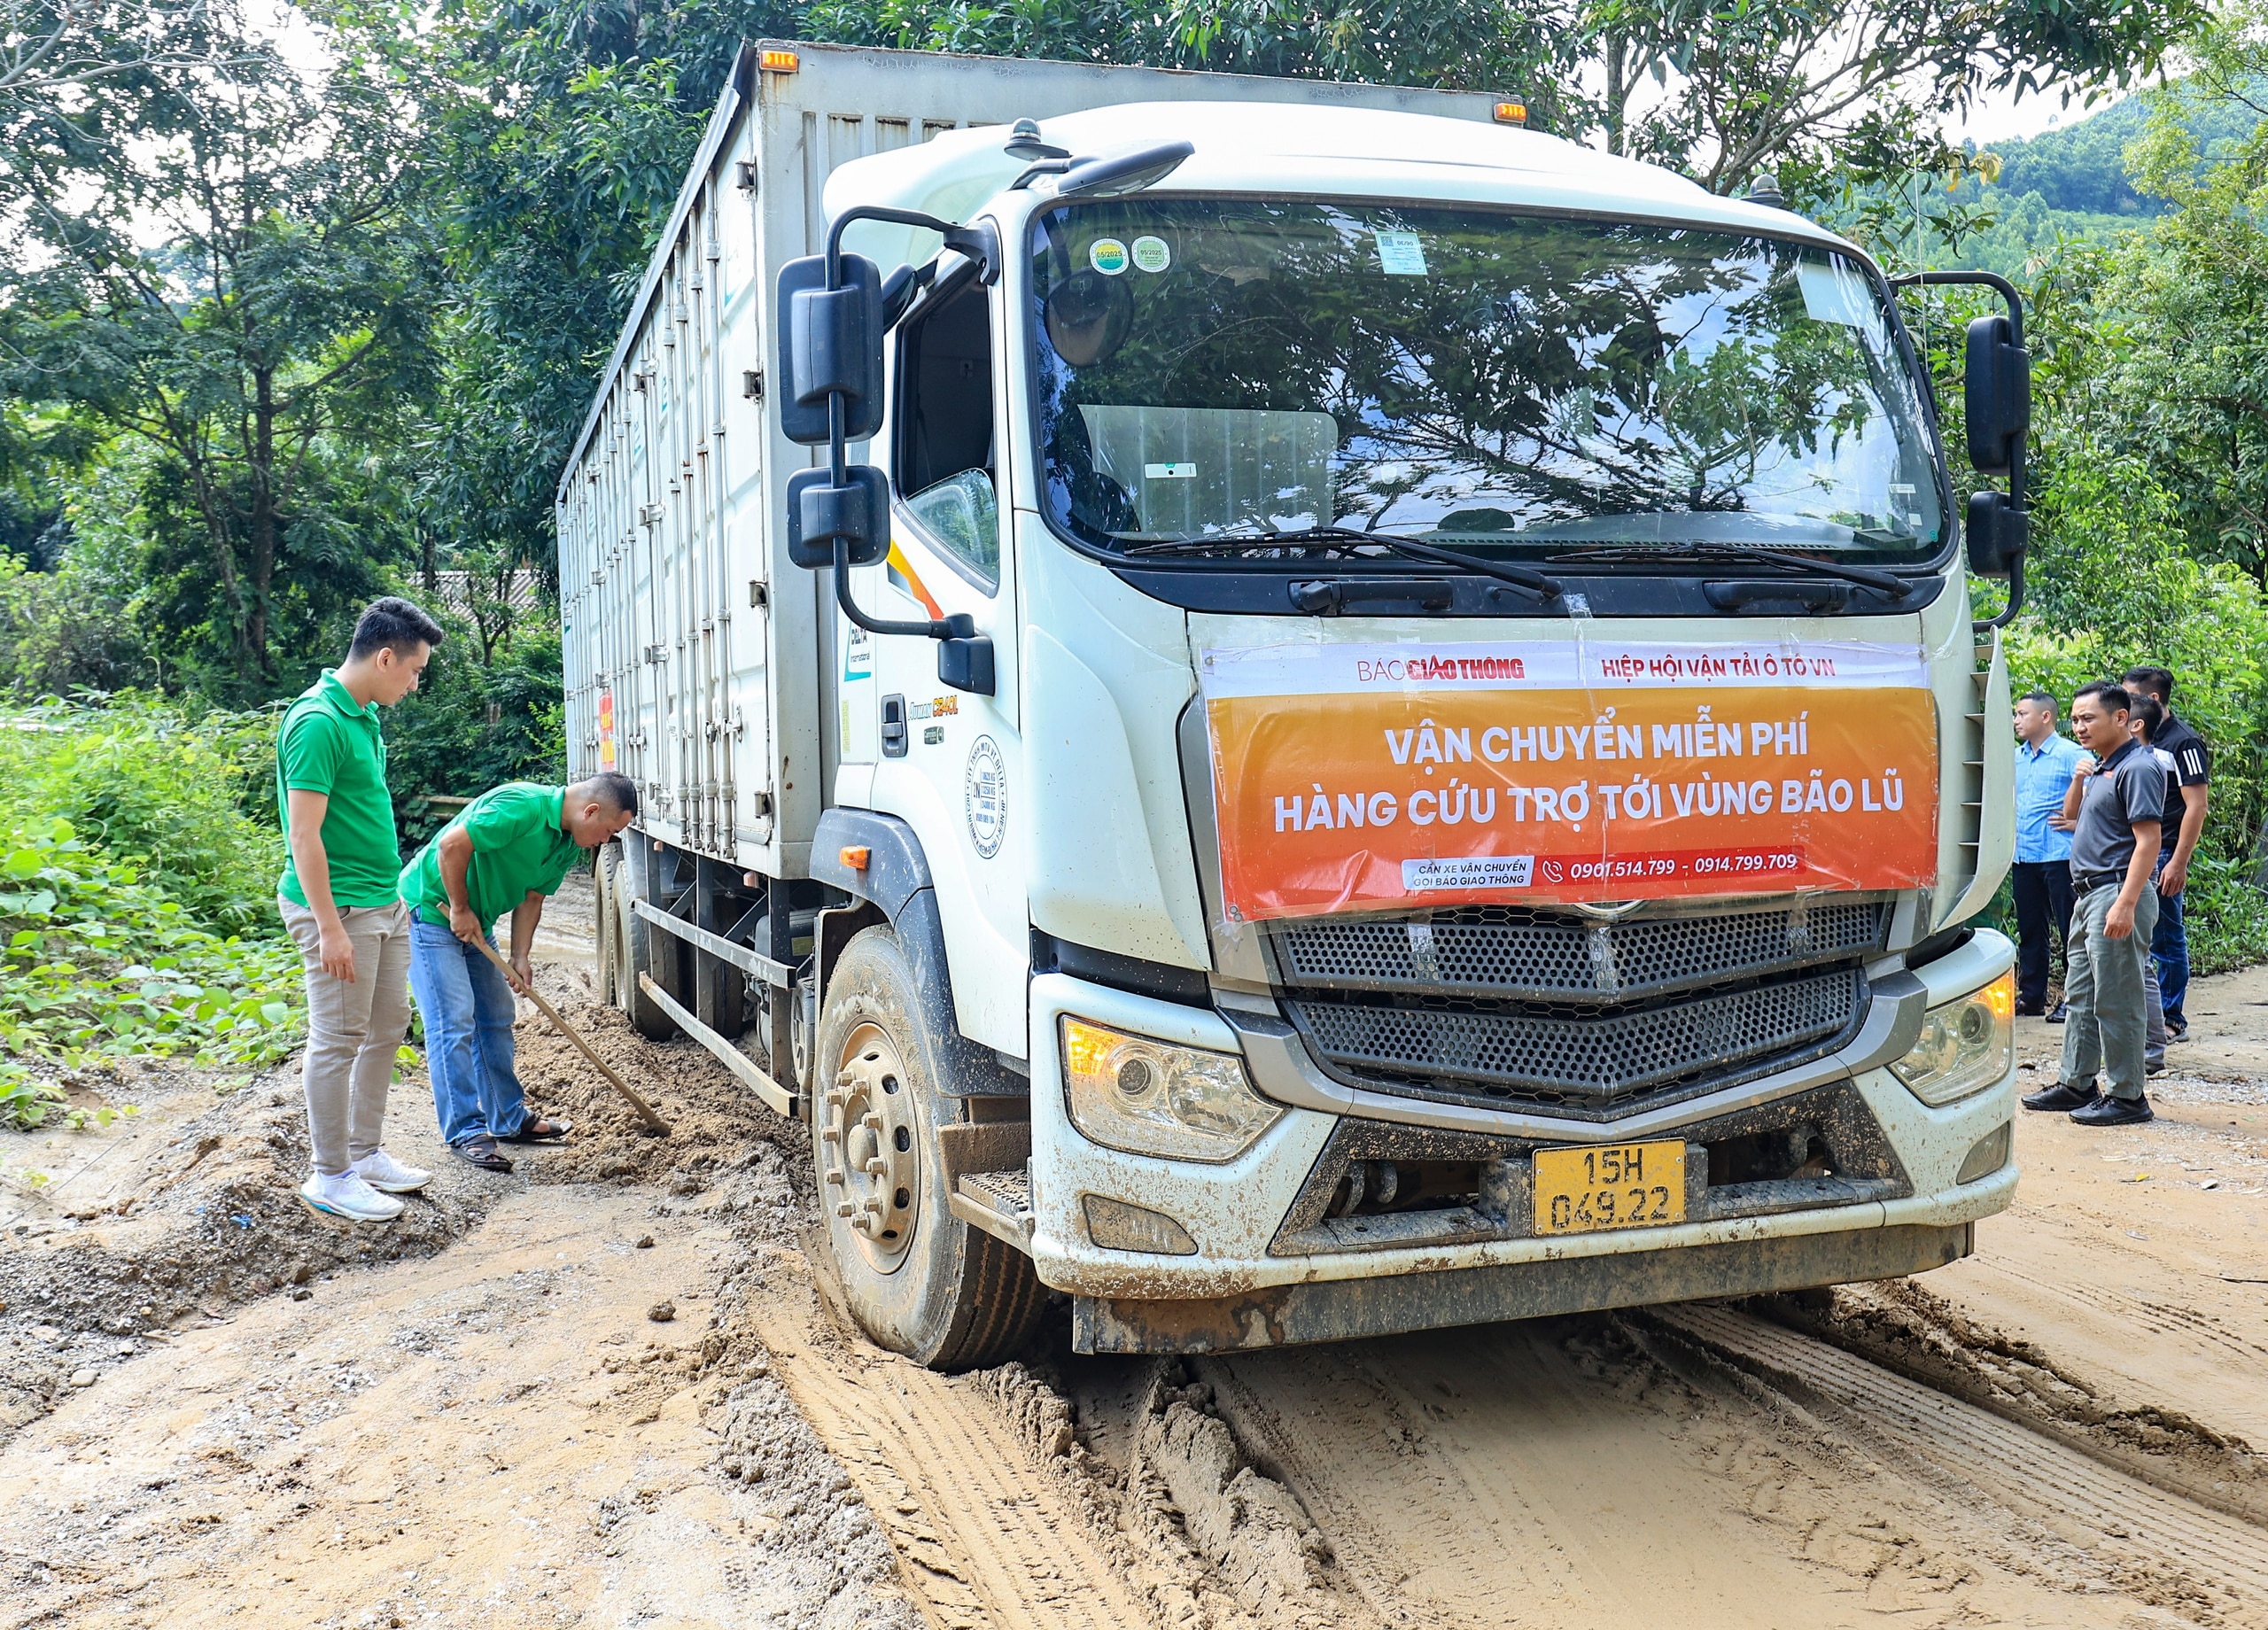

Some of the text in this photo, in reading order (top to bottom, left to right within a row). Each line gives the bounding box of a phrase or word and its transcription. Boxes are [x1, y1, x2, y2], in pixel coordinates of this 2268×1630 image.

[1357, 657, 1405, 681] BÁO
[1601, 652, 1836, 683] HIỆP HỘI VẬN TẢI Ô TÔ VN
[1384, 705, 1808, 775] VẬN CHUYỂN MIỄN PHÍ
[1274, 768, 1904, 832] HÀNG CỨU TRỢ TỚI VÙNG BÃO LŨ
[1418, 862, 1441, 874] CẦN
[1460, 862, 1481, 874] VẬN
[1484, 859, 1526, 873] CHUYỂN
[1695, 854, 1798, 873] 0914.799.709
[1414, 873, 1524, 889] GỌI BÁO GIAO THÔNG
[1583, 1148, 1643, 1185] 15H
[1551, 1185, 1669, 1229] 049.22
